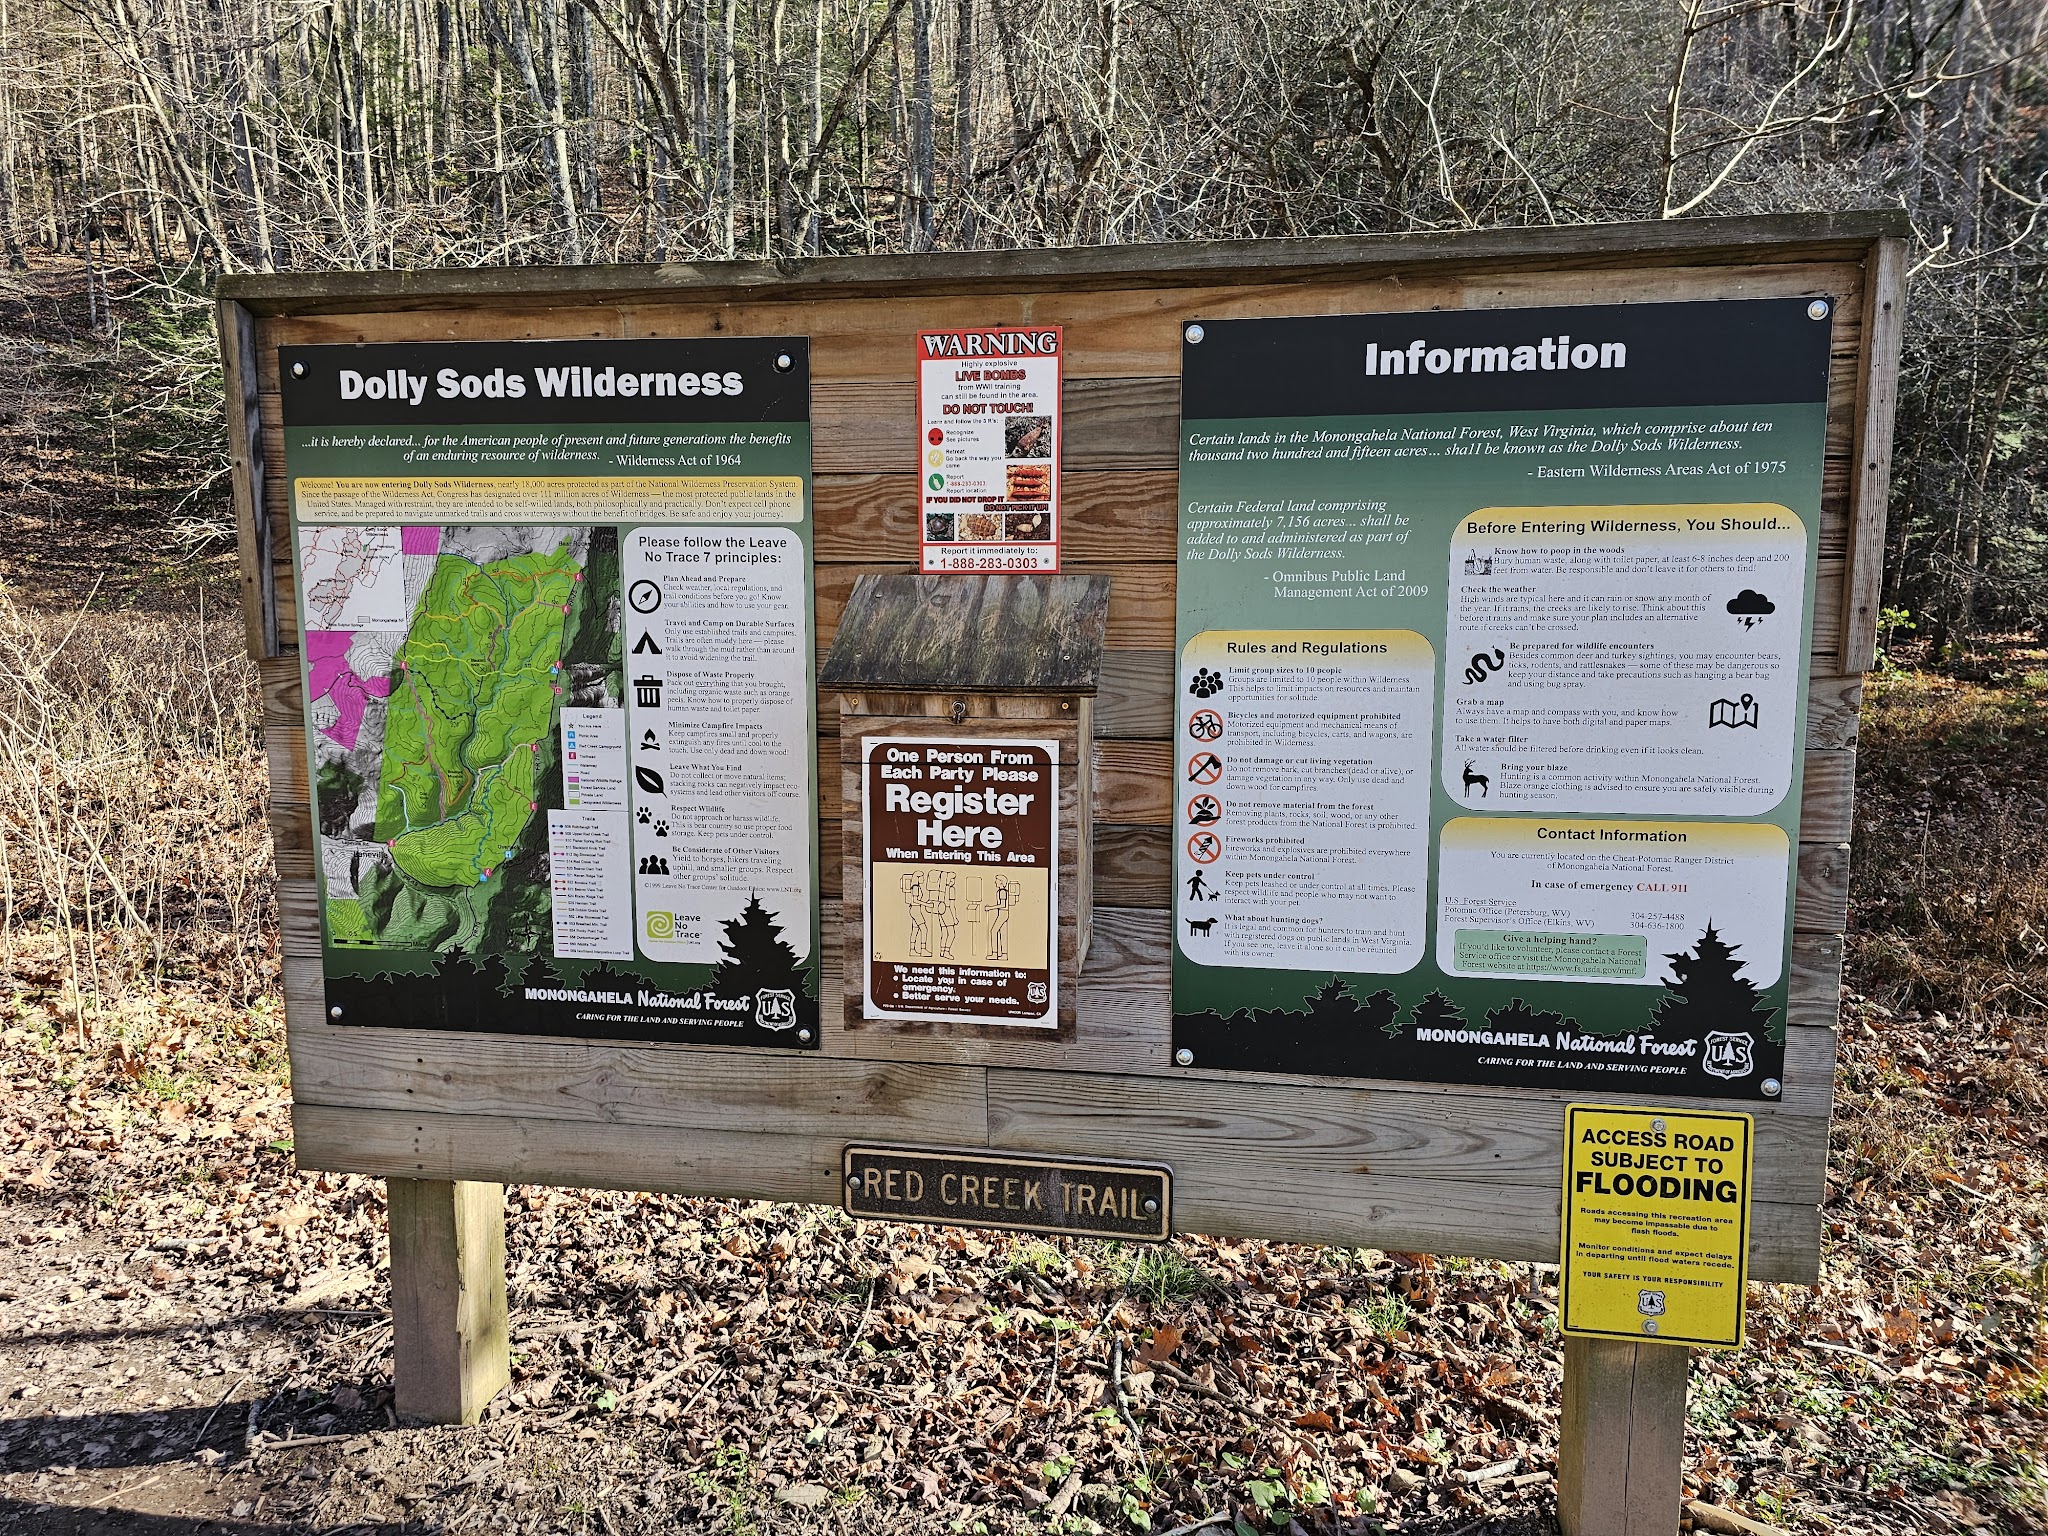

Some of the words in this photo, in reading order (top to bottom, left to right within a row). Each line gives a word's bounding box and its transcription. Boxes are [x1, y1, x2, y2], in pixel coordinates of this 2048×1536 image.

[923, 332, 1057, 356] WARNING
[1366, 334, 1626, 375] Information
[961, 360, 984, 369] Highly
[984, 359, 1018, 368] explosive
[955, 371, 980, 381] LIVE
[983, 369, 1026, 380] BOMBS
[339, 369, 428, 406] Dolly
[436, 367, 527, 399] Sods
[534, 365, 744, 398] Wilderness
[994, 382, 1021, 391] training
[943, 404, 960, 414] DO
[962, 403, 987, 413] NOT
[988, 402, 1033, 412] TOUCH!
[1189, 433, 1235, 446] Certain
[1237, 431, 1271, 445] lands
[1274, 431, 1287, 444] in
[1289, 430, 1309, 443] the
[1311, 428, 1398, 445] Monongahela
[1400, 426, 1457, 441] National
[1458, 426, 1504, 441] Forest,
[1509, 425, 1540, 439] West
[1543, 421, 1598, 441] Virginia,
[1602, 421, 1643, 436] which
[1644, 421, 1707, 438] comprise
[1709, 419, 1749, 433] about
[1751, 421, 1773, 432] ten
[403, 449, 414, 464] of
[416, 453, 430, 461] an
[431, 449, 480, 464] enduring
[480, 452, 527, 462] resource
[527, 448, 542, 464] of
[542, 448, 601, 461] wilderness.
[615, 454, 676, 466] Wilderness
[677, 454, 697, 466] Act
[699, 454, 713, 466] of
[715, 454, 742, 466] 1964
[1537, 465, 1585, 478] Eastern
[1589, 463, 1662, 477] Wilderness
[1664, 463, 1704, 476] Areas
[1706, 462, 1731, 475] Act
[1734, 461, 1752, 475] of
[1754, 460, 1787, 474] 1975
[1467, 521, 1517, 534] Before
[1521, 520, 1586, 536] Entering
[1590, 519, 1681, 532] Wilderness,
[1686, 518, 1716, 531] You
[1720, 517, 1790, 531] Should...
[639, 536, 680, 548] Please
[683, 536, 722, 548] follow
[725, 536, 746, 548] the
[749, 536, 787, 548] Leave
[644, 551, 662, 562] No
[665, 551, 700, 563] Trace
[703, 551, 711, 563] 7
[715, 551, 781, 566] principles:
[941, 547, 968, 556] Report
[977, 546, 1025, 556] immediately
[1494, 547, 1519, 555] Know
[1520, 547, 1537, 555] how
[1550, 548, 1571, 556] poop
[1583, 546, 1597, 554] the
[1599, 546, 1625, 554] woods
[940, 557, 1037, 568] 1-888-283-0303
[718, 575, 746, 584] Prepare
[1272, 570, 1328, 583] Omnibus
[1331, 569, 1371, 582] Public
[1374, 569, 1406, 582] Land
[1274, 586, 1353, 601] Management
[1355, 585, 1378, 597] Act
[1380, 584, 1397, 597] of
[1397, 584, 1429, 597] 2009
[1460, 585, 1487, 593] Check
[1489, 585, 1502, 593] the
[1503, 585, 1537, 593] weather
[1227, 641, 1267, 654] Rules
[1270, 641, 1297, 654] and
[1302, 641, 1388, 657] Regulations
[1229, 666, 1250, 674] Limit
[1251, 668, 1275, 676] group
[1276, 666, 1294, 674] sizes
[1316, 666, 1342, 676] people
[886, 747, 920, 763] One
[926, 748, 984, 764] Person
[990, 749, 1034, 765] From
[880, 764, 923, 780] Each
[929, 765, 975, 784] Party
[982, 766, 1039, 783] Please
[885, 783, 1034, 819] Register
[917, 819, 1002, 847] Here
[1225, 835, 1264, 843] Fireworks
[1265, 836, 1305, 845] prohibited
[1537, 827, 1596, 840] Contact
[1600, 828, 1687, 843] Information
[885, 847, 919, 859] When
[923, 848, 972, 863] Entering
[976, 850, 1002, 862] This
[1006, 851, 1036, 863] Area
[1531, 879, 1543, 890] In
[1544, 882, 1566, 890] case
[1567, 880, 1579, 891] of
[1580, 882, 1635, 894] emergency
[1635, 882, 1670, 893] CALL
[1670, 883, 1689, 894] 911
[525, 987, 632, 1004] MONONGAHELA
[638, 990, 701, 1010] National
[704, 994, 749, 1011] Forest
[1416, 1027, 1550, 1047] MONONGAHELA
[1556, 1031, 1636, 1055] National
[1639, 1035, 1697, 1056] Forest
[1477, 1056, 1514, 1066] CARING
[1514, 1058, 1535, 1067] FOR
[1536, 1059, 1556, 1068] THE
[1557, 1060, 1584, 1070] LAND
[1583, 1062, 1605, 1071] AND
[1605, 1063, 1649, 1073] SERVING
[1649, 1065, 1688, 1075] PEOPLE
[1581, 1128, 1666, 1147] ACCESS
[1674, 1133, 1734, 1151] ROAD
[1591, 1151, 1687, 1171] SUBJECT
[1694, 1158, 1723, 1173] TO
[863, 1168, 923, 1201] RED
[940, 1173, 1042, 1211] CREEK
[1061, 1182, 1147, 1220] TRAIL
[1576, 1171, 1737, 1202] FLOODING
[1580, 1207, 1606, 1215] Roads
[1607, 1210, 1649, 1219] accessing
[1669, 1214, 1712, 1223] recreation
[1582, 1270, 1602, 1278] YOUR
[1604, 1272, 1631, 1280] SAFETY
[1642, 1275, 1662, 1283] YOUR
[1664, 1277, 1724, 1288] RESPONSIBILITY
